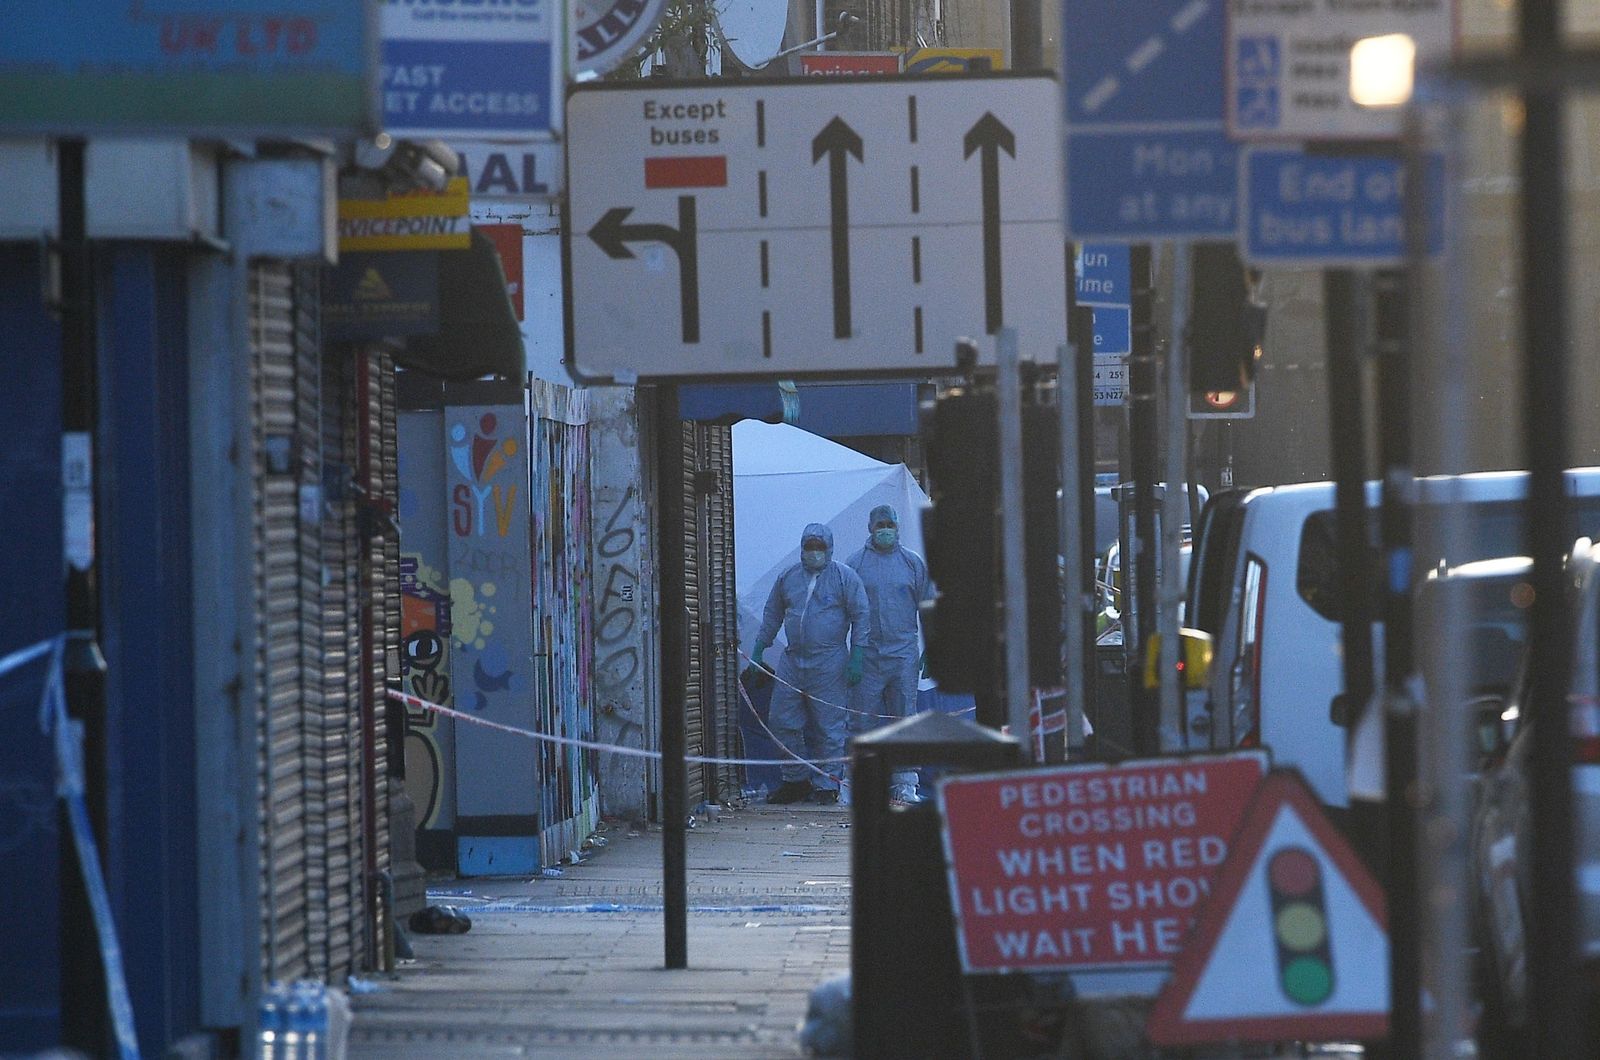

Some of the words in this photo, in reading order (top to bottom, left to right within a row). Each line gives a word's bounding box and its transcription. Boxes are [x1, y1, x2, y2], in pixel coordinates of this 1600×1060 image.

[235, 16, 316, 54] LTD
[429, 91, 541, 114] ACCESS
[643, 98, 726, 122] Except
[650, 127, 720, 146] buses
[457, 153, 548, 194] AL
[1133, 145, 1213, 176] Mon
[1279, 160, 1354, 204] End
[1119, 191, 1158, 222] at
[1170, 196, 1231, 224] any
[1260, 209, 1332, 244] bus
[1109, 371, 1124, 379] 259
[453, 483, 516, 537] SYV
[1000, 770, 1208, 809] PEDESTRIAN
[1019, 802, 1197, 838] CROSSING
[997, 844, 1127, 878] WHEN
[1142, 836, 1228, 869] RED
[971, 883, 1092, 916] LIGHT
[1106, 877, 1209, 912] SHO
[995, 928, 1096, 958] WAIT
[1111, 918, 1196, 955] HE
